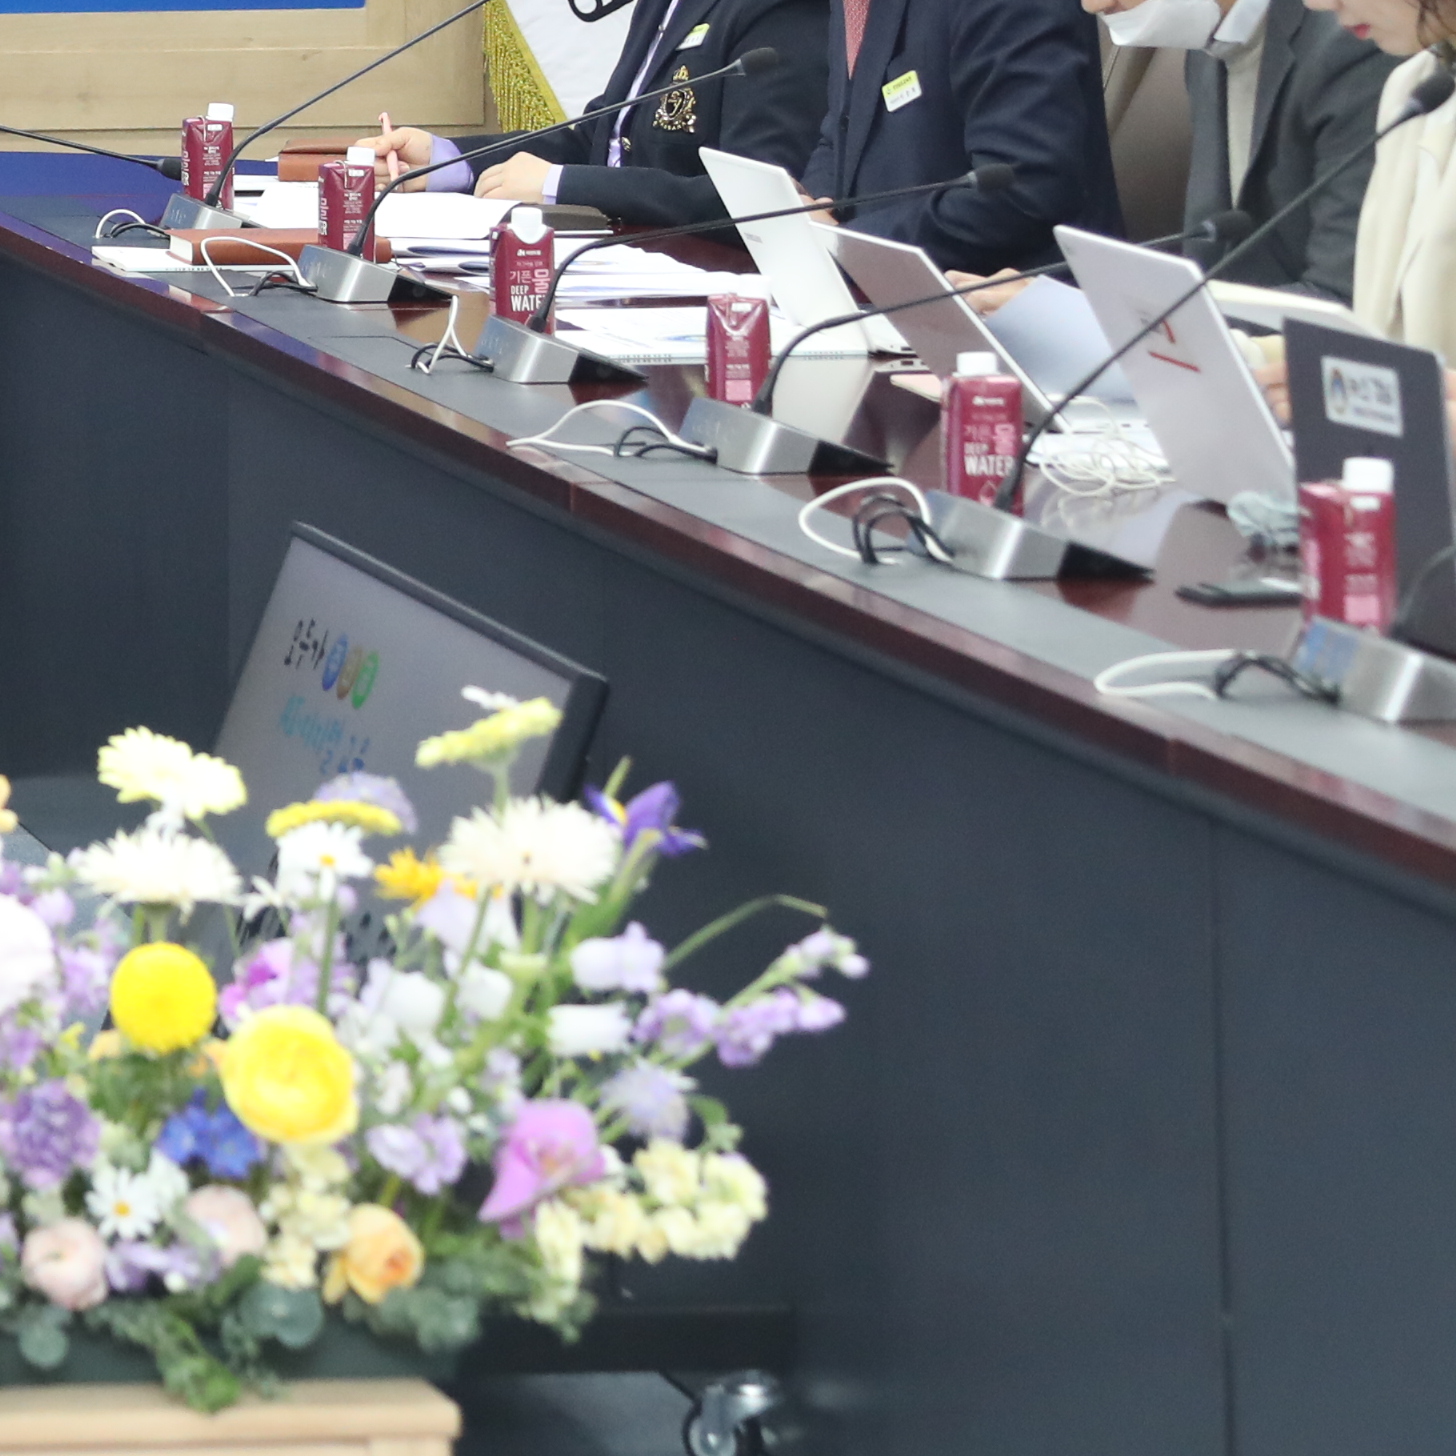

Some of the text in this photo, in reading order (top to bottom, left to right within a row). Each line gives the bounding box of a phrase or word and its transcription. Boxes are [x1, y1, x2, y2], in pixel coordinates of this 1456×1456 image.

[509, 268, 551, 294] 기픈 물
[510, 285, 529, 295] DEEP
[511, 294, 546, 312] WATE
[964, 454, 1015, 477] WATER
